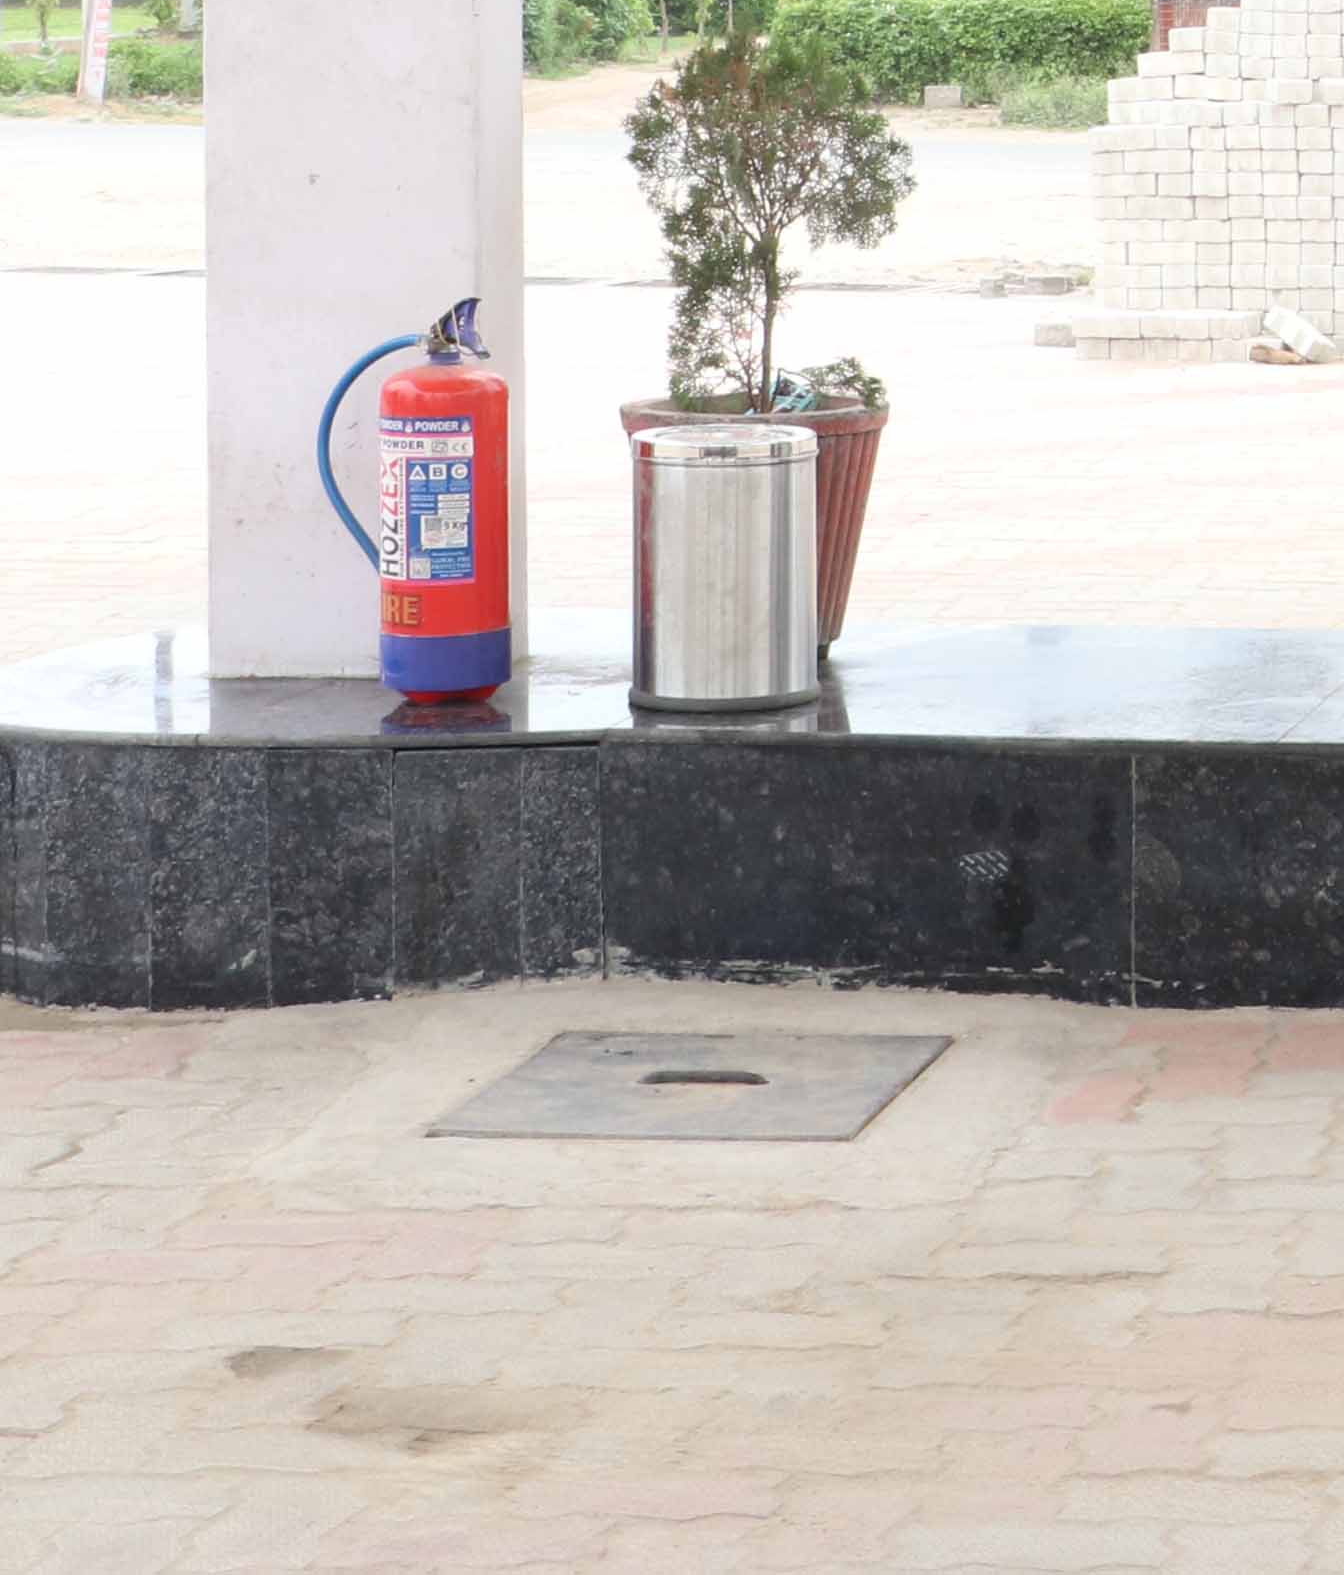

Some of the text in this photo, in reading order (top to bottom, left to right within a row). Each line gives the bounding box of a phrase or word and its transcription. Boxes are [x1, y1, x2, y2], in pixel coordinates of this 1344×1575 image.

[414, 421, 459, 432] POWDER
[382, 457, 399, 577] HOZZEX
[383, 593, 419, 625] IRE
